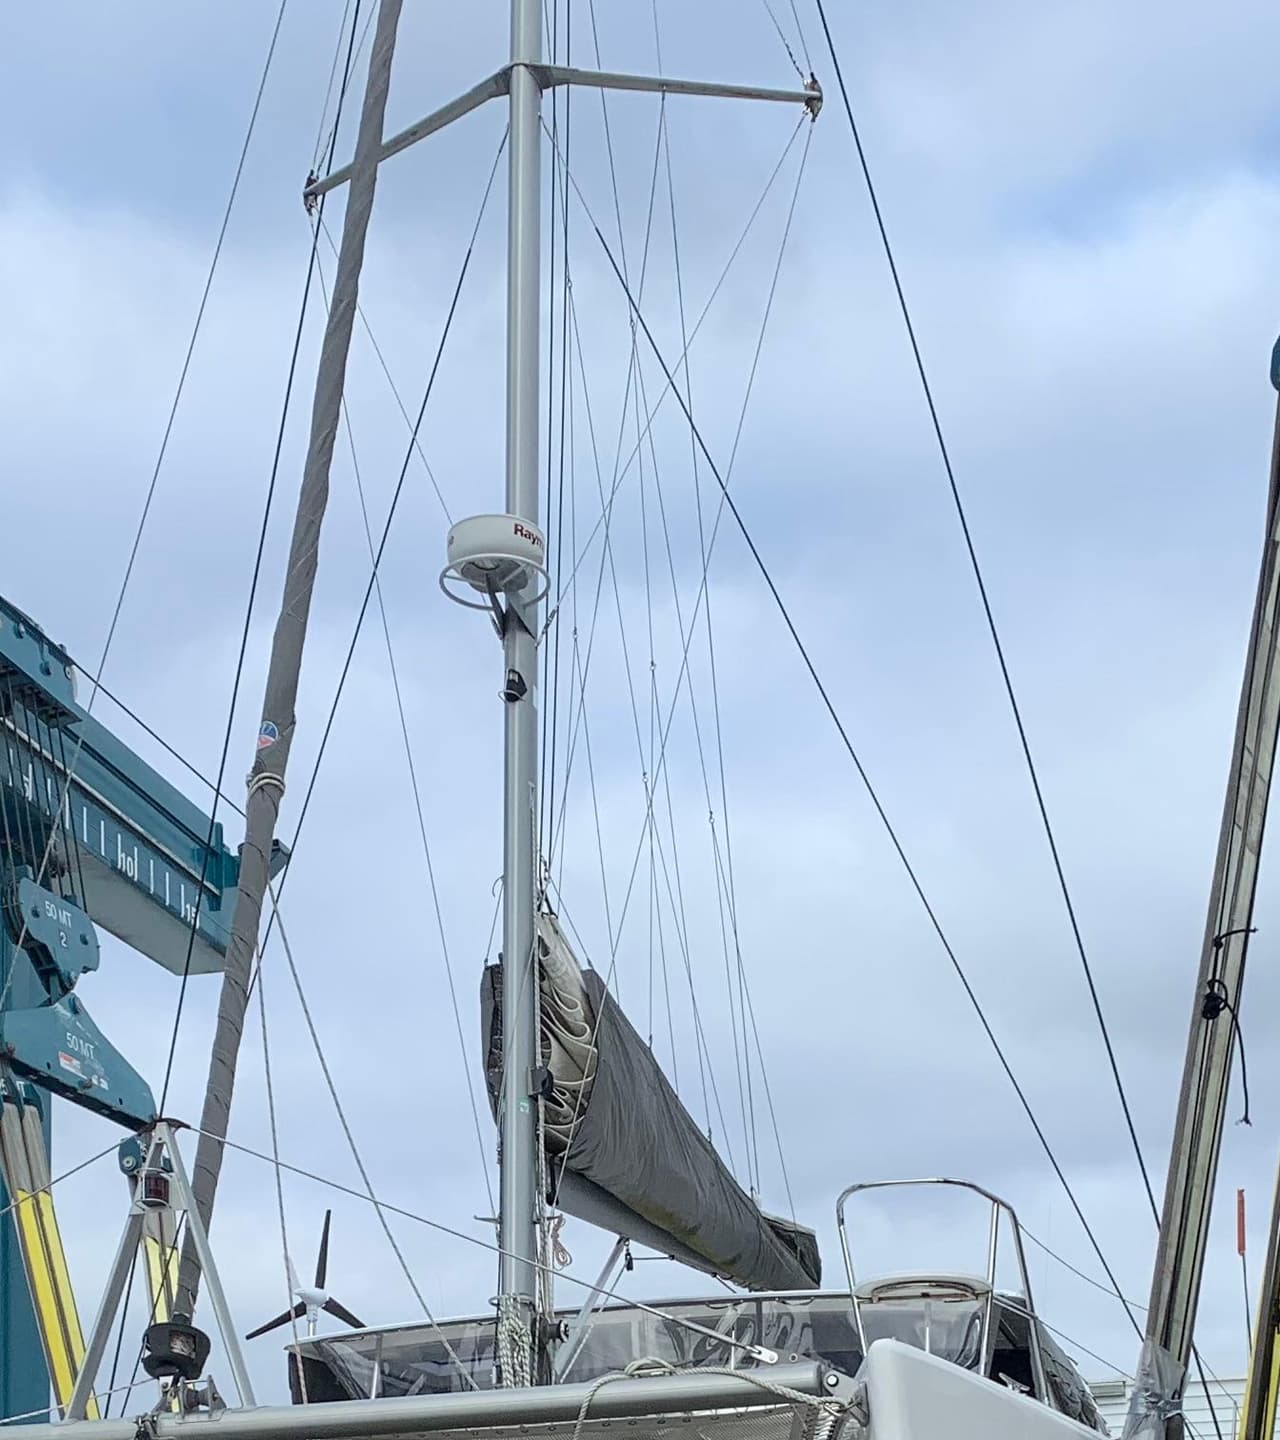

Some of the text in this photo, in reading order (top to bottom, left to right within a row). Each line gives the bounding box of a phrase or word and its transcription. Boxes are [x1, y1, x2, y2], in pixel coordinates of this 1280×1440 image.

[45, 900, 58, 920] 50
[60, 931, 68, 948] 2
[66, 1031, 79, 1051] 50
